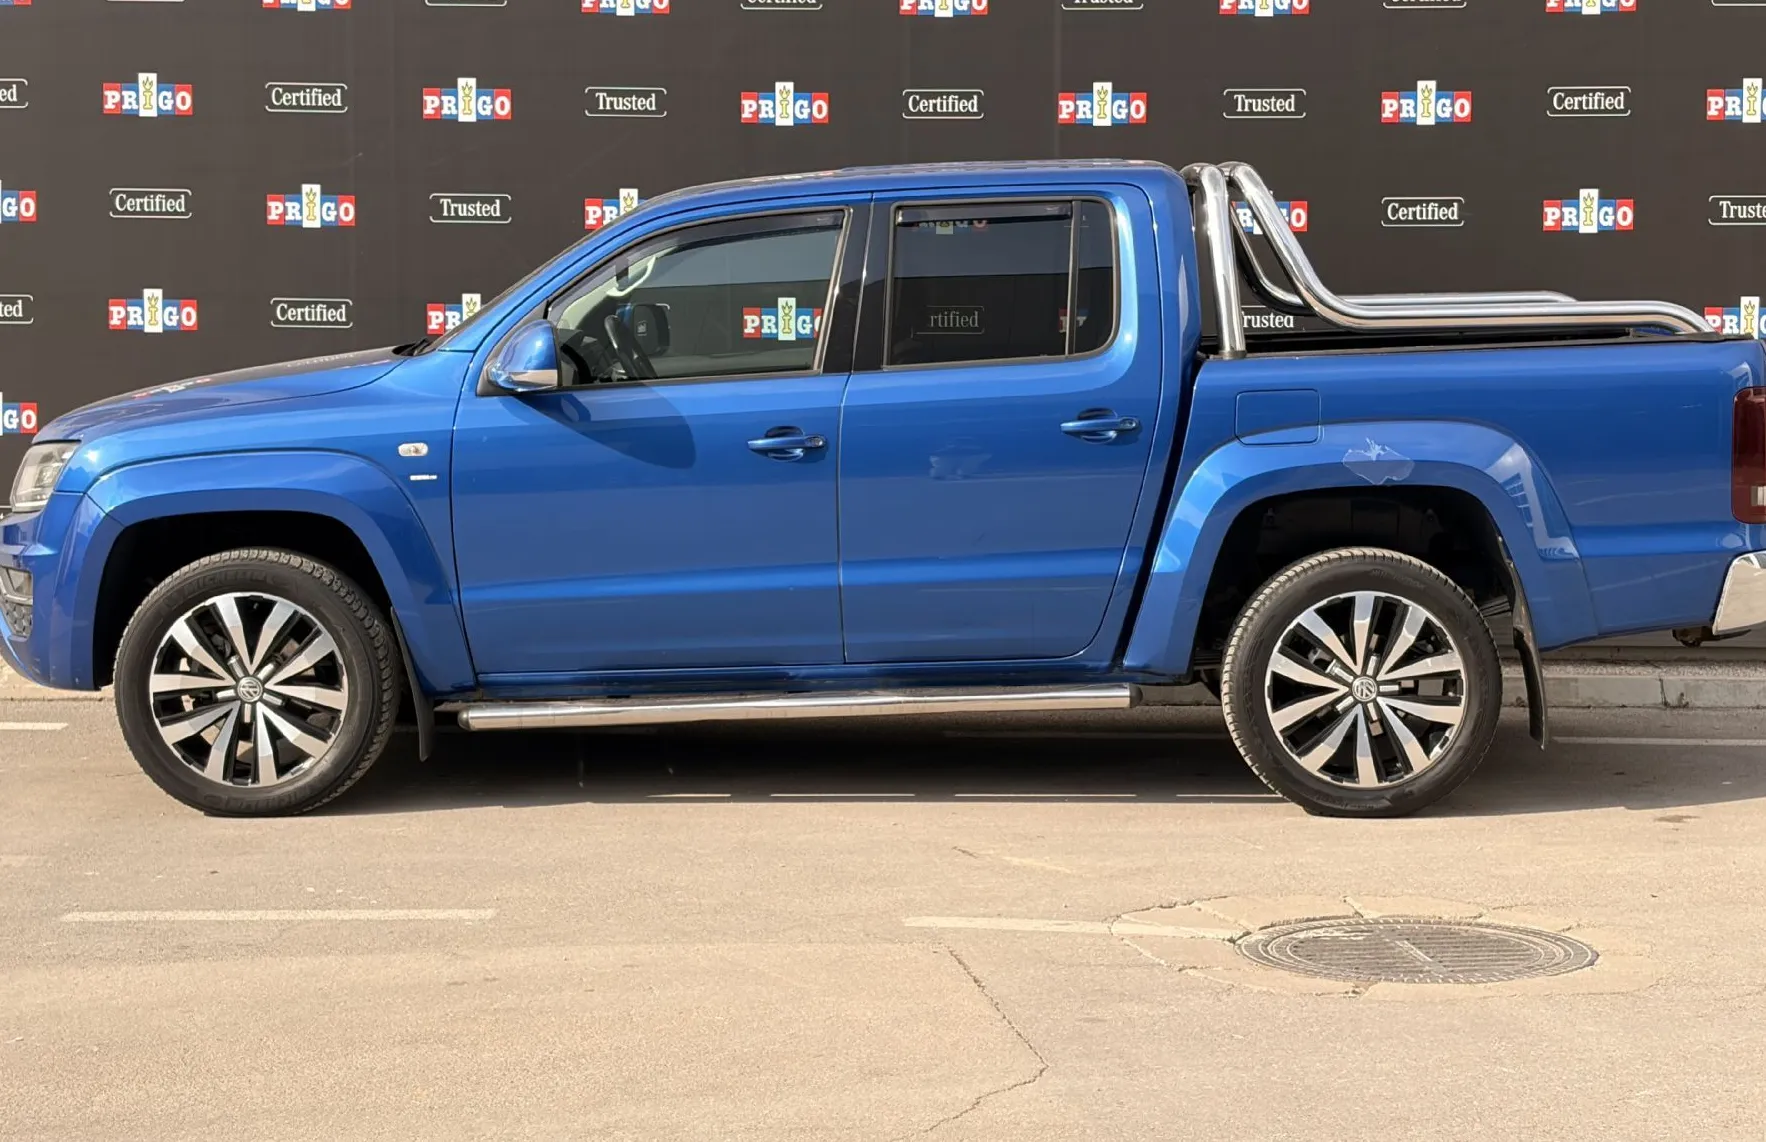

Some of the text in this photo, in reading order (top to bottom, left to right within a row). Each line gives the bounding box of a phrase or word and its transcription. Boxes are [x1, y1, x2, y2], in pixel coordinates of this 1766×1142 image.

[103, 86, 192, 112] PRIGO
[270, 86, 343, 107] Certified
[423, 91, 511, 117] PRIGO
[595, 92, 657, 111] Trusted
[908, 94, 979, 113] Certified
[1233, 94, 1296, 113] Trusted
[1552, 91, 1625, 111] Certified
[1707, 92, 1766, 117] PRI
[741, 95, 829, 121] PRIGO
[1058, 95, 1147, 121] PRIGO
[1382, 94, 1472, 120] PRIGO
[114, 193, 186, 213] Certified
[267, 198, 355, 224] PRIGO
[439, 198, 501, 217] Trusted
[1387, 201, 1459, 221] Certified
[1544, 203, 1633, 229] PRIGO
[109, 302, 197, 328] PRIGO
[276, 303, 347, 322] Certified
[930, 311, 979, 328] rtified
[1241, 311, 1295, 329] rusted
